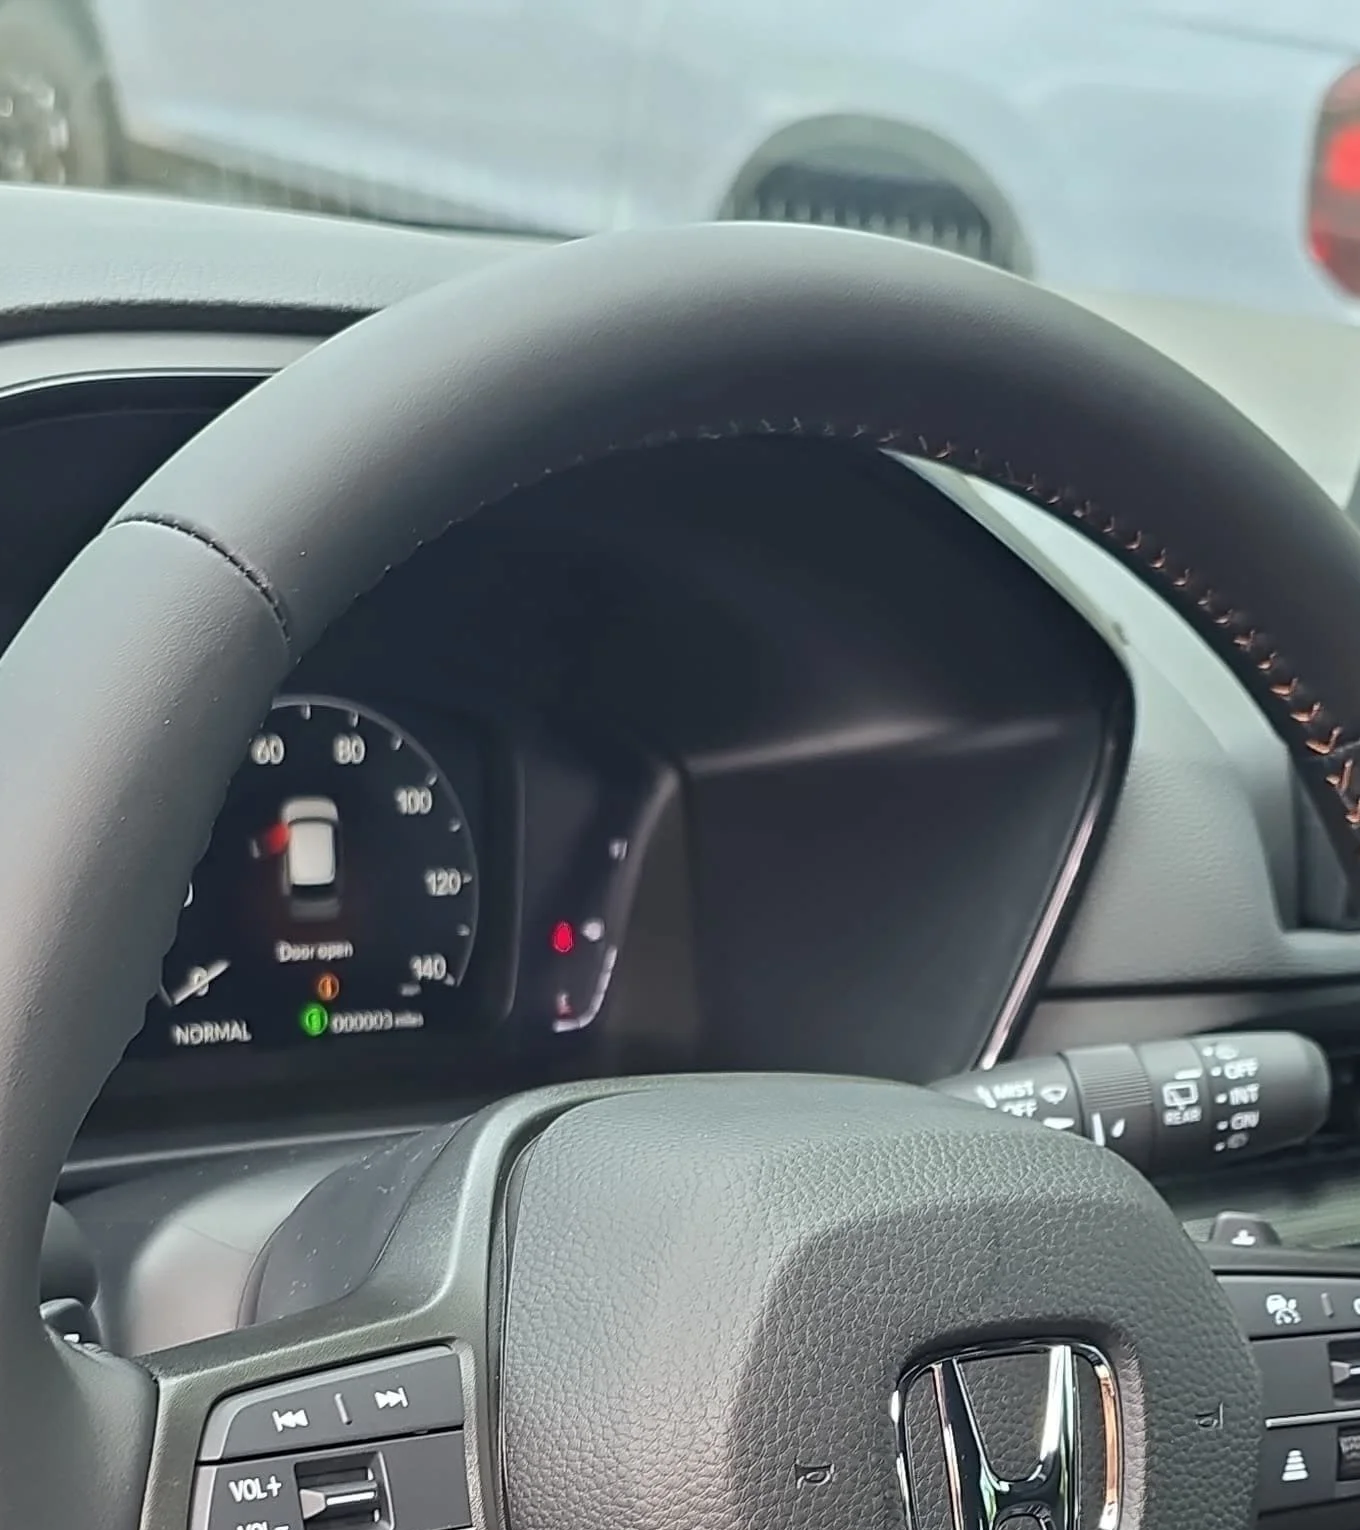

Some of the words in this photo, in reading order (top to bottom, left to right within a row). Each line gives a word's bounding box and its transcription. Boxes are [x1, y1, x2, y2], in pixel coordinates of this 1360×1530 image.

[251, 733, 285, 765] 60
[333, 734, 365, 765] 80
[395, 786, 433, 815] 100
[425, 868, 462, 896] 120
[275, 940, 315, 962] Door
[317, 941, 354, 961] open
[410, 954, 446, 980] 140
[171, 1020, 252, 1046] NORMAL
[1224, 1057, 1259, 1080] OFF
[1163, 1106, 1202, 1126] REAR
